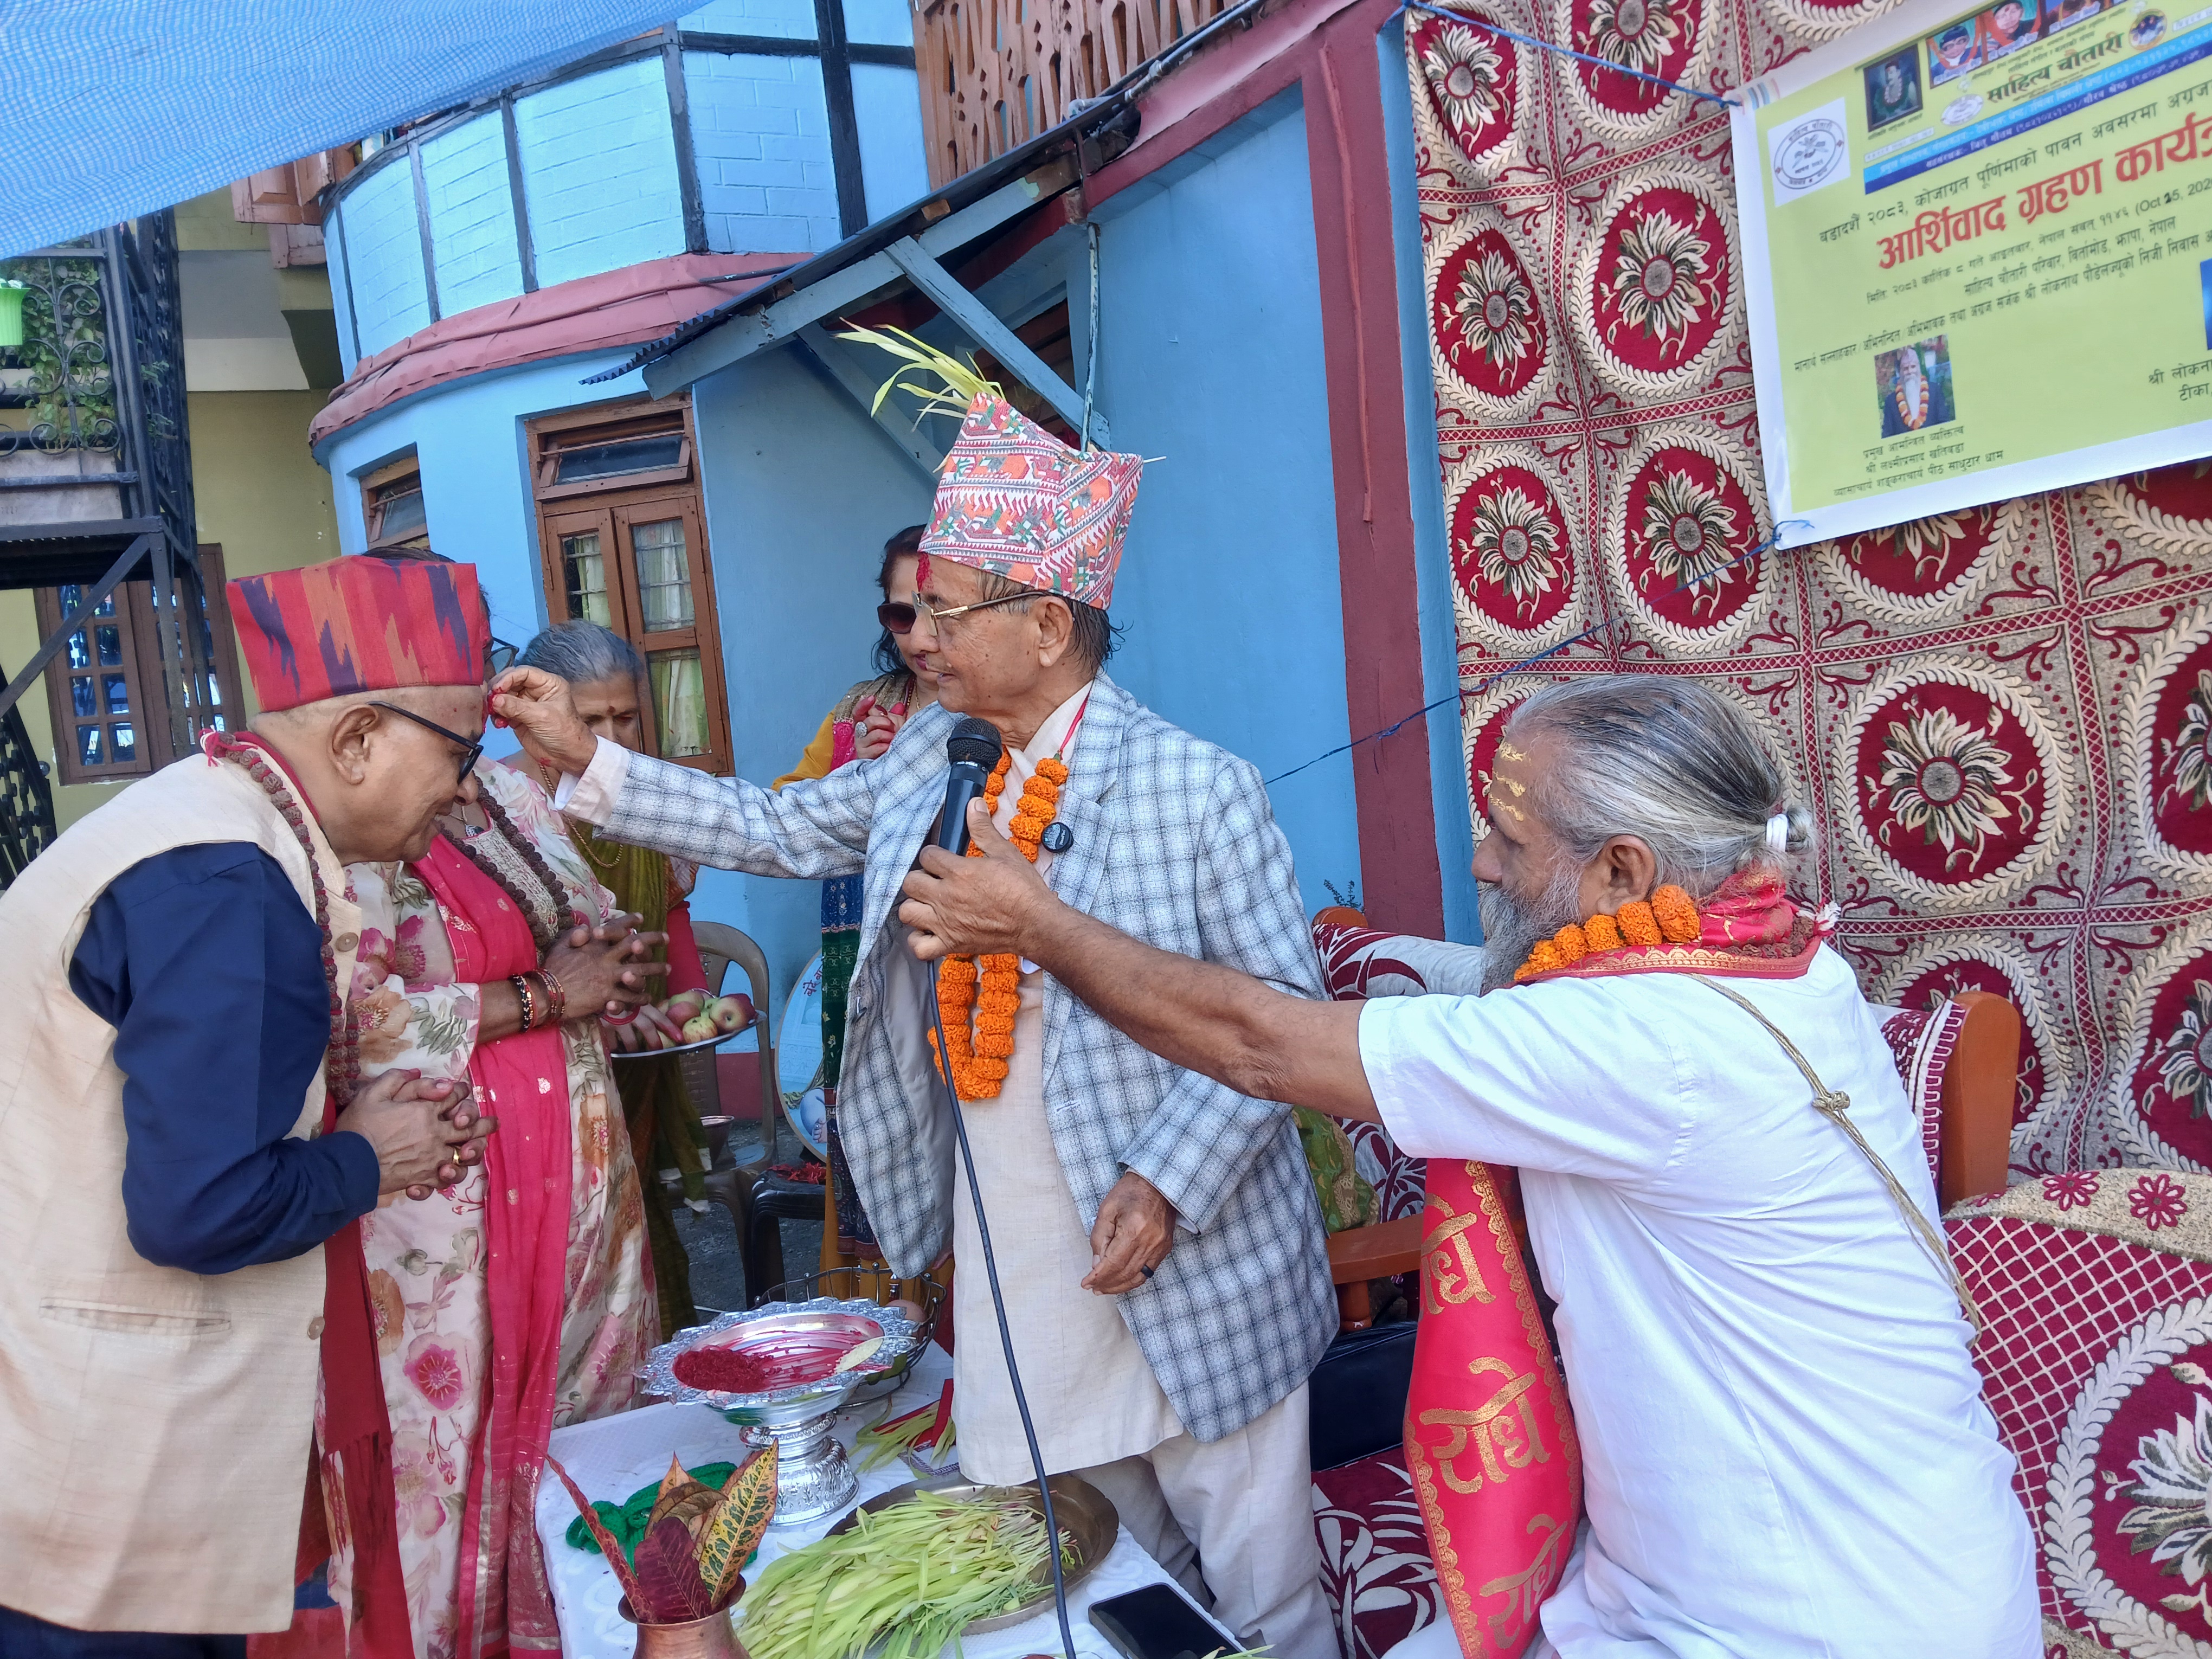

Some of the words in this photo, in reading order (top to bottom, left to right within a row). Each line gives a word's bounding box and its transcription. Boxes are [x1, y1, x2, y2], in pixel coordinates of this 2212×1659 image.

[1987, 63, 2053, 103] साहित्य
[2056, 31, 2125, 70] चौतारी
[1976, 147, 2037, 189] पूर्णिमाको
[2044, 132, 2083, 157] पावन
[2091, 101, 2158, 139] अवसरमा
[2167, 79, 2212, 108] अग्रज
[1876, 195, 2008, 269] आर्शिवाद
[2016, 158, 2104, 224] ग्रहण
[2135, 196, 2161, 216] (Oct
[2187, 177, 2212, 196] 202
[2148, 216, 2176, 236] नेपाल
[2139, 242, 2163, 266] निजी
[2166, 234, 2200, 257] निवास
[2149, 368, 2165, 384] श्री
[2170, 359, 2212, 379] लोकना
[1420, 1192, 1496, 1315] ाधे
[1419, 1355, 1550, 1495] राधे
